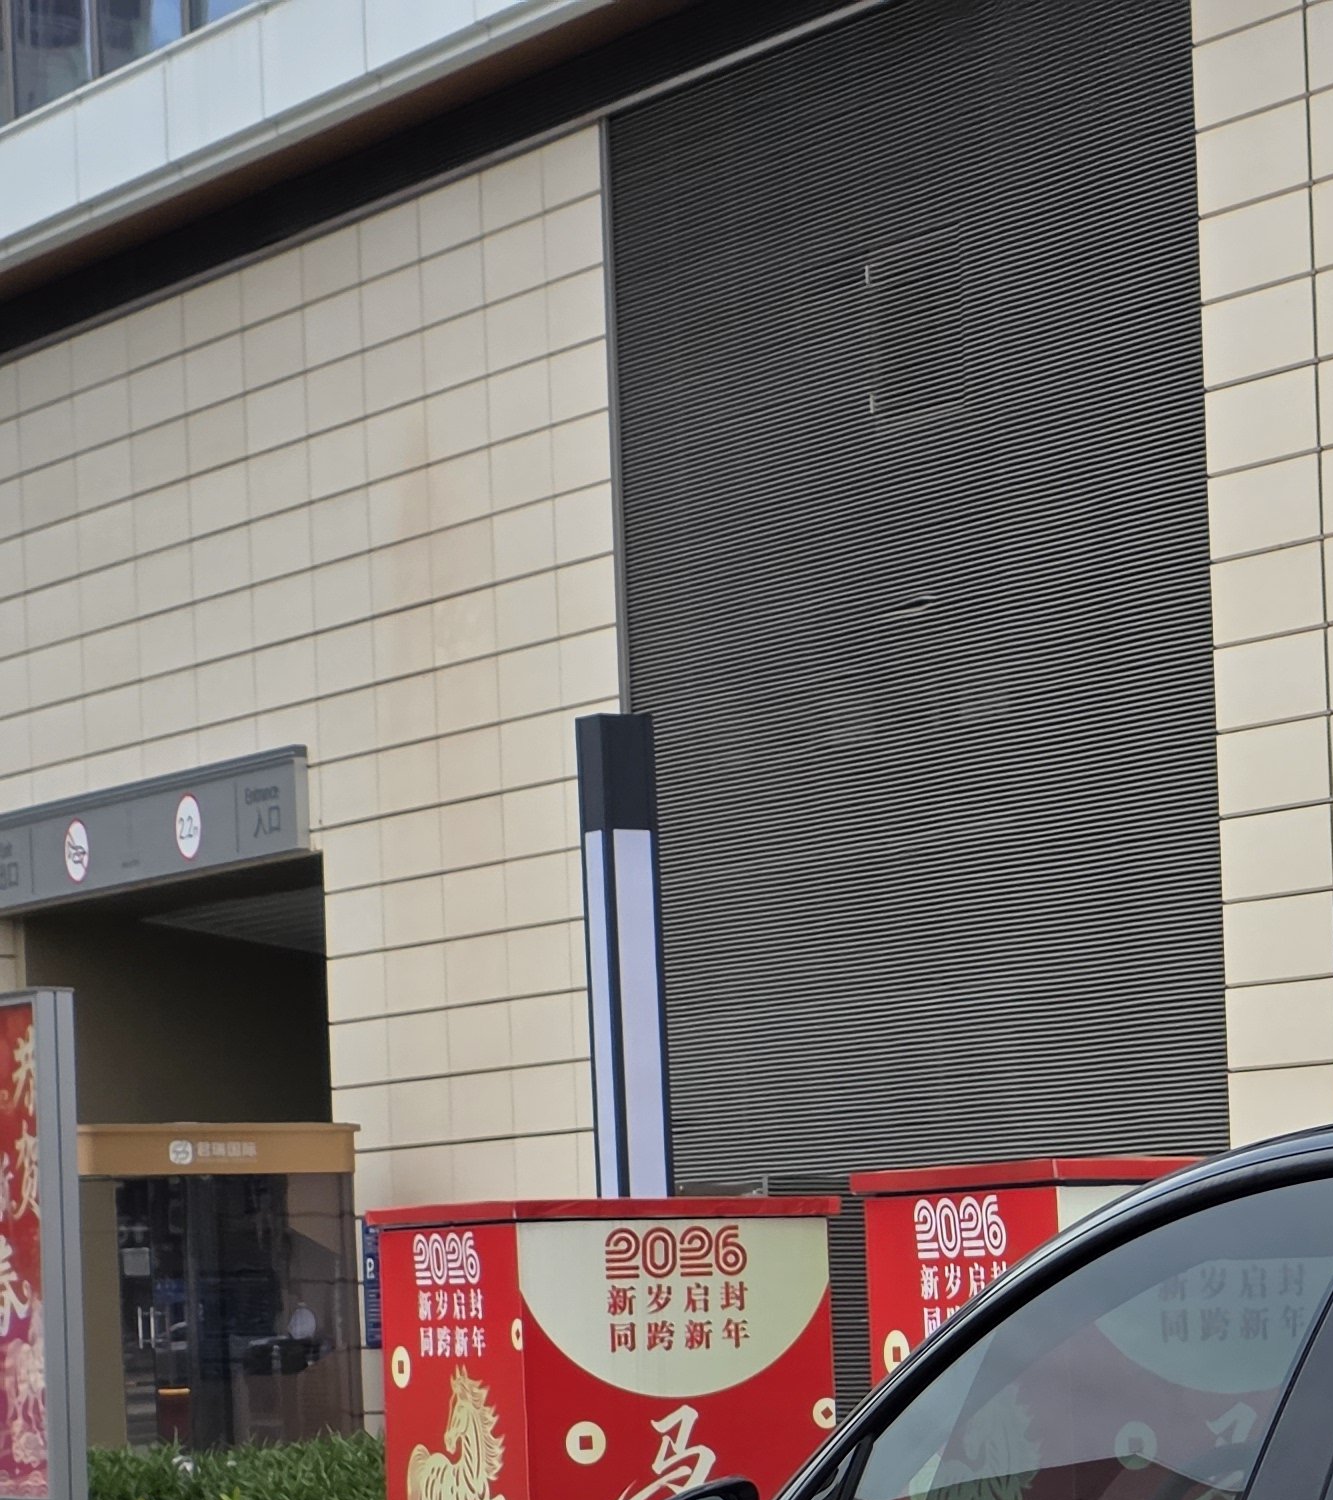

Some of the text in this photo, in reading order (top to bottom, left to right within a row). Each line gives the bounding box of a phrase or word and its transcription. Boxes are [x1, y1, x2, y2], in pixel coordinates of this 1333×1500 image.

[913, 1194, 1007, 1260] 2026
[413, 1230, 481, 1286] 2026
[605, 1224, 748, 1280] 2026
[417, 1287, 484, 1321] 新岁启封
[607, 1281, 749, 1316] 新岁启封
[419, 1325, 487, 1358] 同跨新年
[609, 1317, 751, 1354] 同跨新年
